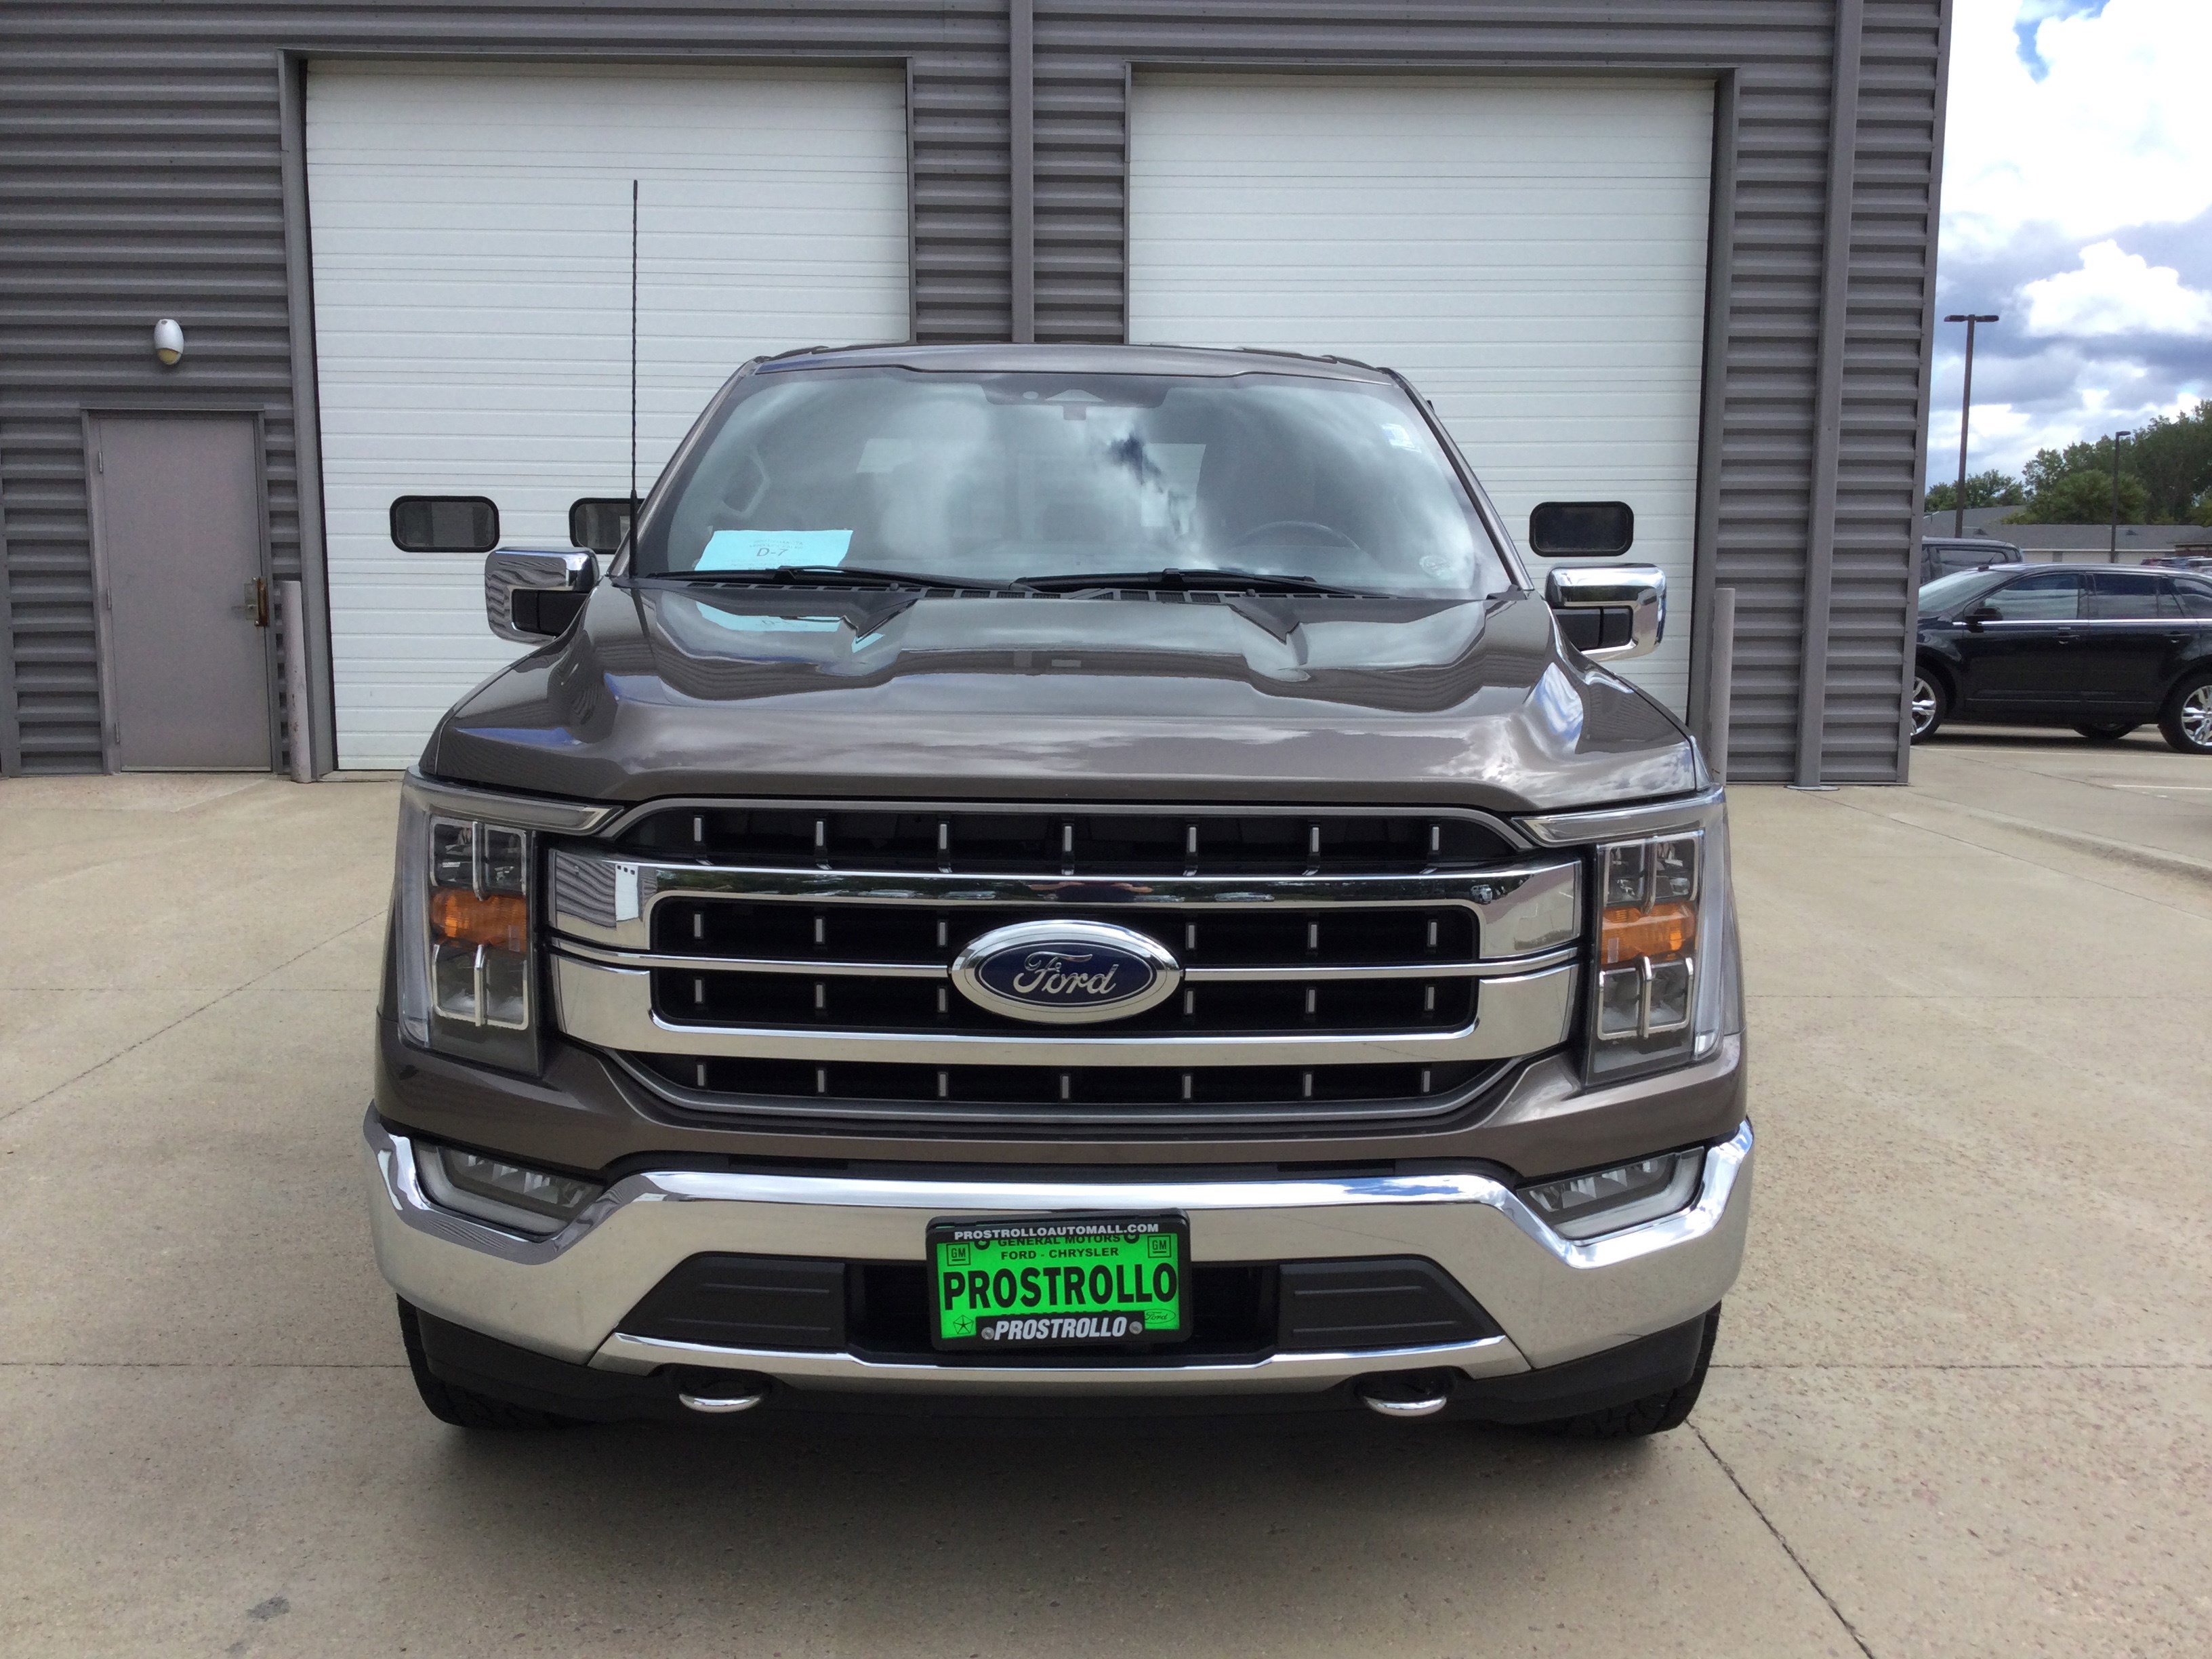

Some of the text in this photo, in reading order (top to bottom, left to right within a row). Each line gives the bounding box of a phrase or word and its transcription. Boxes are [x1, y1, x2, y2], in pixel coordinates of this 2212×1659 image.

[1013, 951, 1120, 994] Ford
[954, 1223, 1160, 1240] PROSTROLLOAUTOMALL.COM
[998, 1234, 1121, 1247] GENERAL MOTORS
[1152, 1240, 1167, 1251] GM
[951, 1248, 966, 1258] GM
[1001, 1250, 1037, 1261] FORD
[1048, 1247, 1120, 1258] CHRYSLER
[943, 1262, 1178, 1311] PROSTROLLO
[1145, 1311, 1168, 1321] Ford
[994, 1316, 1128, 1340] PROSTROLLO
